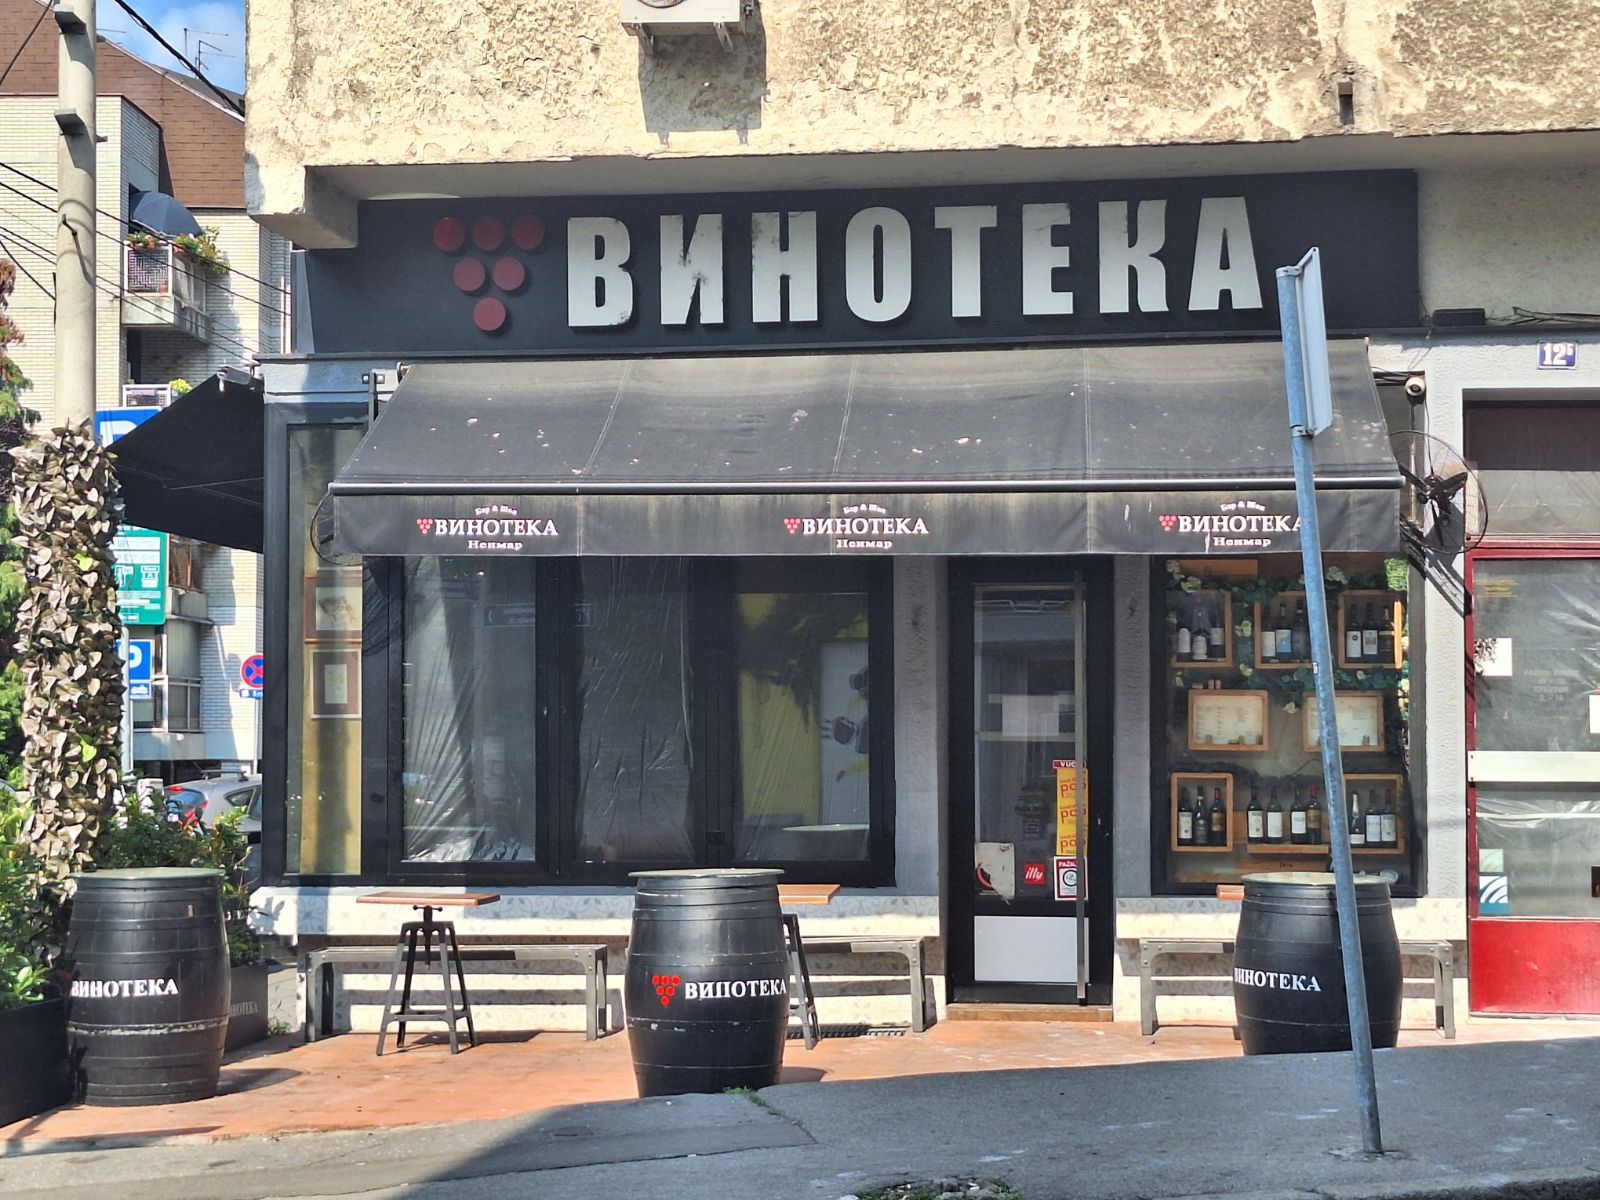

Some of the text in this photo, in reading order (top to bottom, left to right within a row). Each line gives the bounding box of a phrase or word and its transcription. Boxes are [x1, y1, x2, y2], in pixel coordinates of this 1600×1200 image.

[567, 197, 1263, 326] ВИНОТЕКА
[434, 519, 558, 536] ВИНОТЕКА
[802, 518, 928, 535] ВИНОТЕКА
[1025, 866, 1043, 881] illy
[71, 978, 179, 998] ВИНОТЕКА
